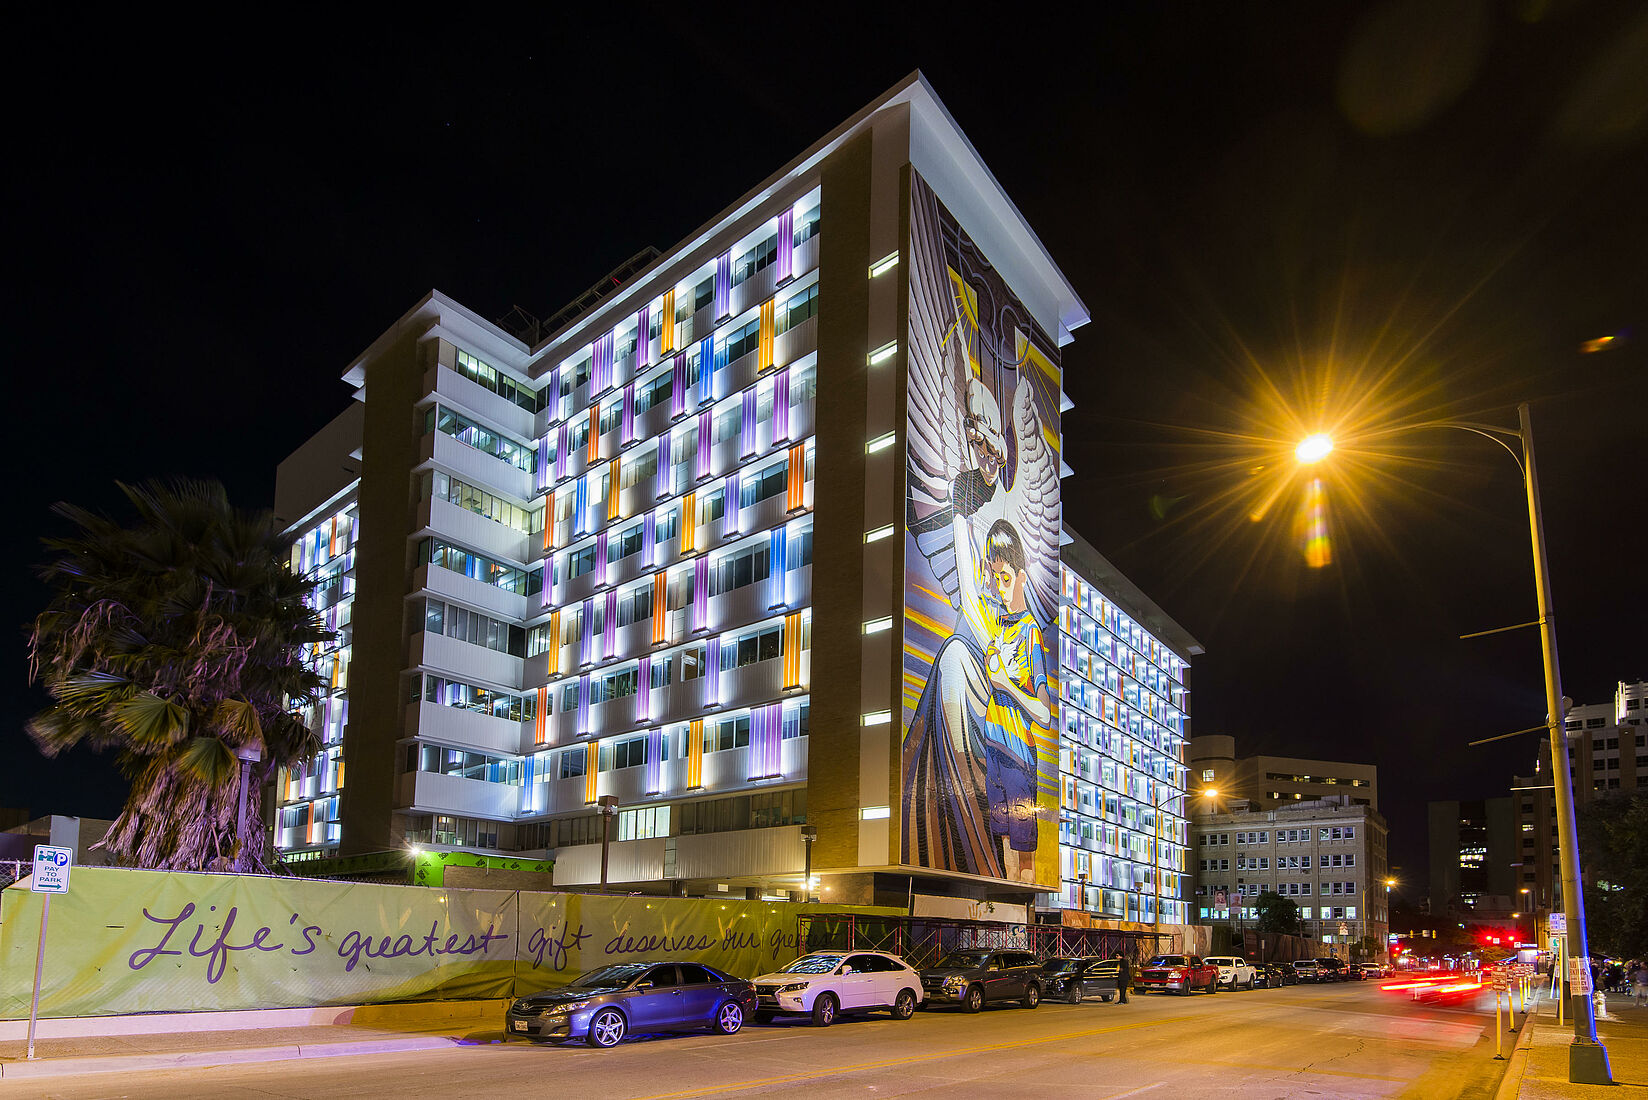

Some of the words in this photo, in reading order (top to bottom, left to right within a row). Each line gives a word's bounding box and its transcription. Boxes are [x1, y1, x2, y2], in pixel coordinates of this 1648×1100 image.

[128, 902, 322, 984] Life's
[338, 920, 508, 972] greatest
[528, 921, 593, 972] gift
[605, 928, 717, 955] deserves
[722, 927, 760, 949] our
